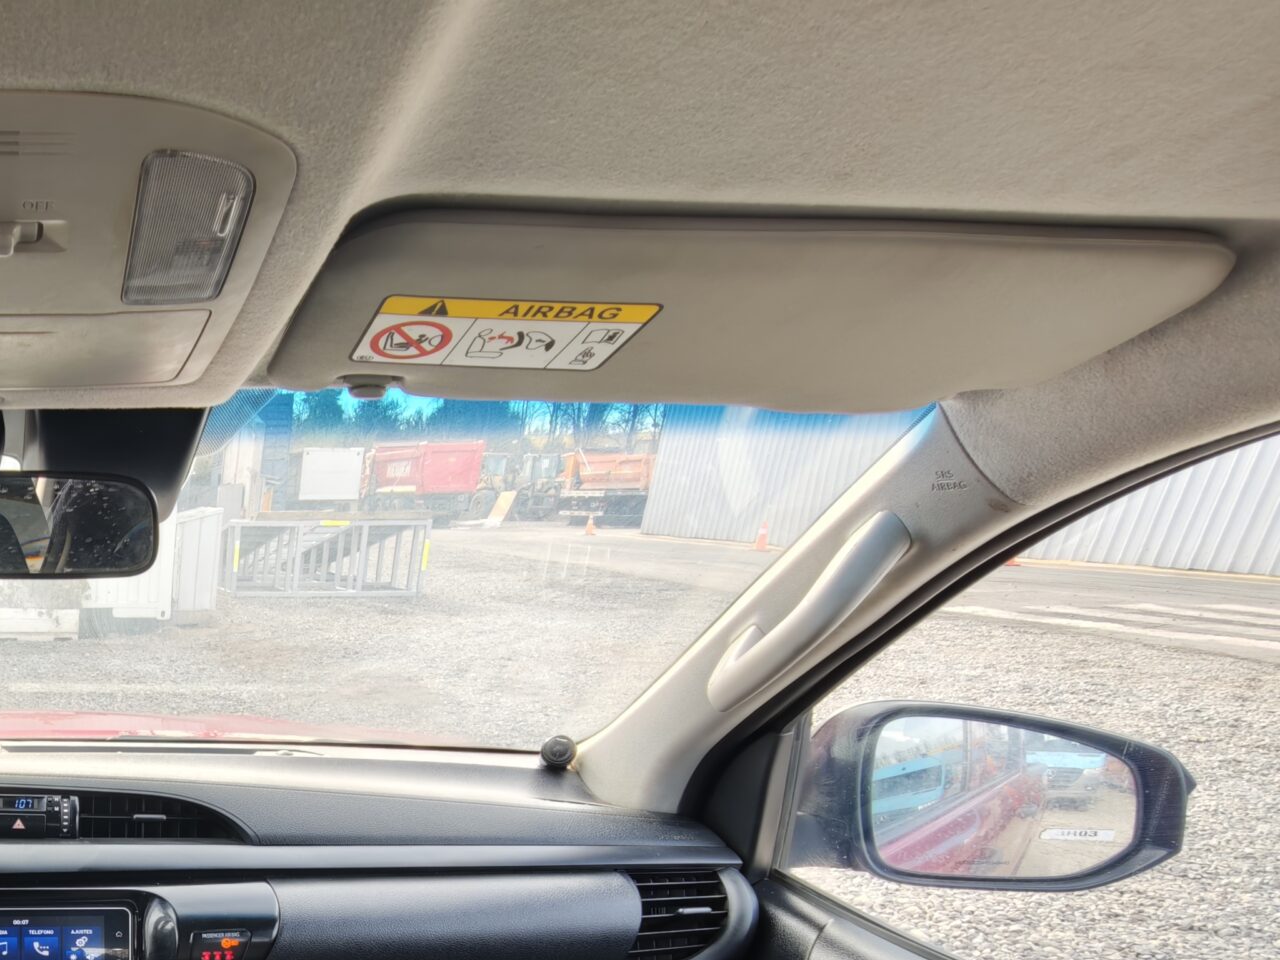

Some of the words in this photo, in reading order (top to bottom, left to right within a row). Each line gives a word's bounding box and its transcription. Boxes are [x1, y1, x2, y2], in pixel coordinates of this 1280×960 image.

[22, 200, 54, 211] OFF
[498, 303, 623, 321] AIRBAG
[931, 480, 968, 491] AIRBAG
